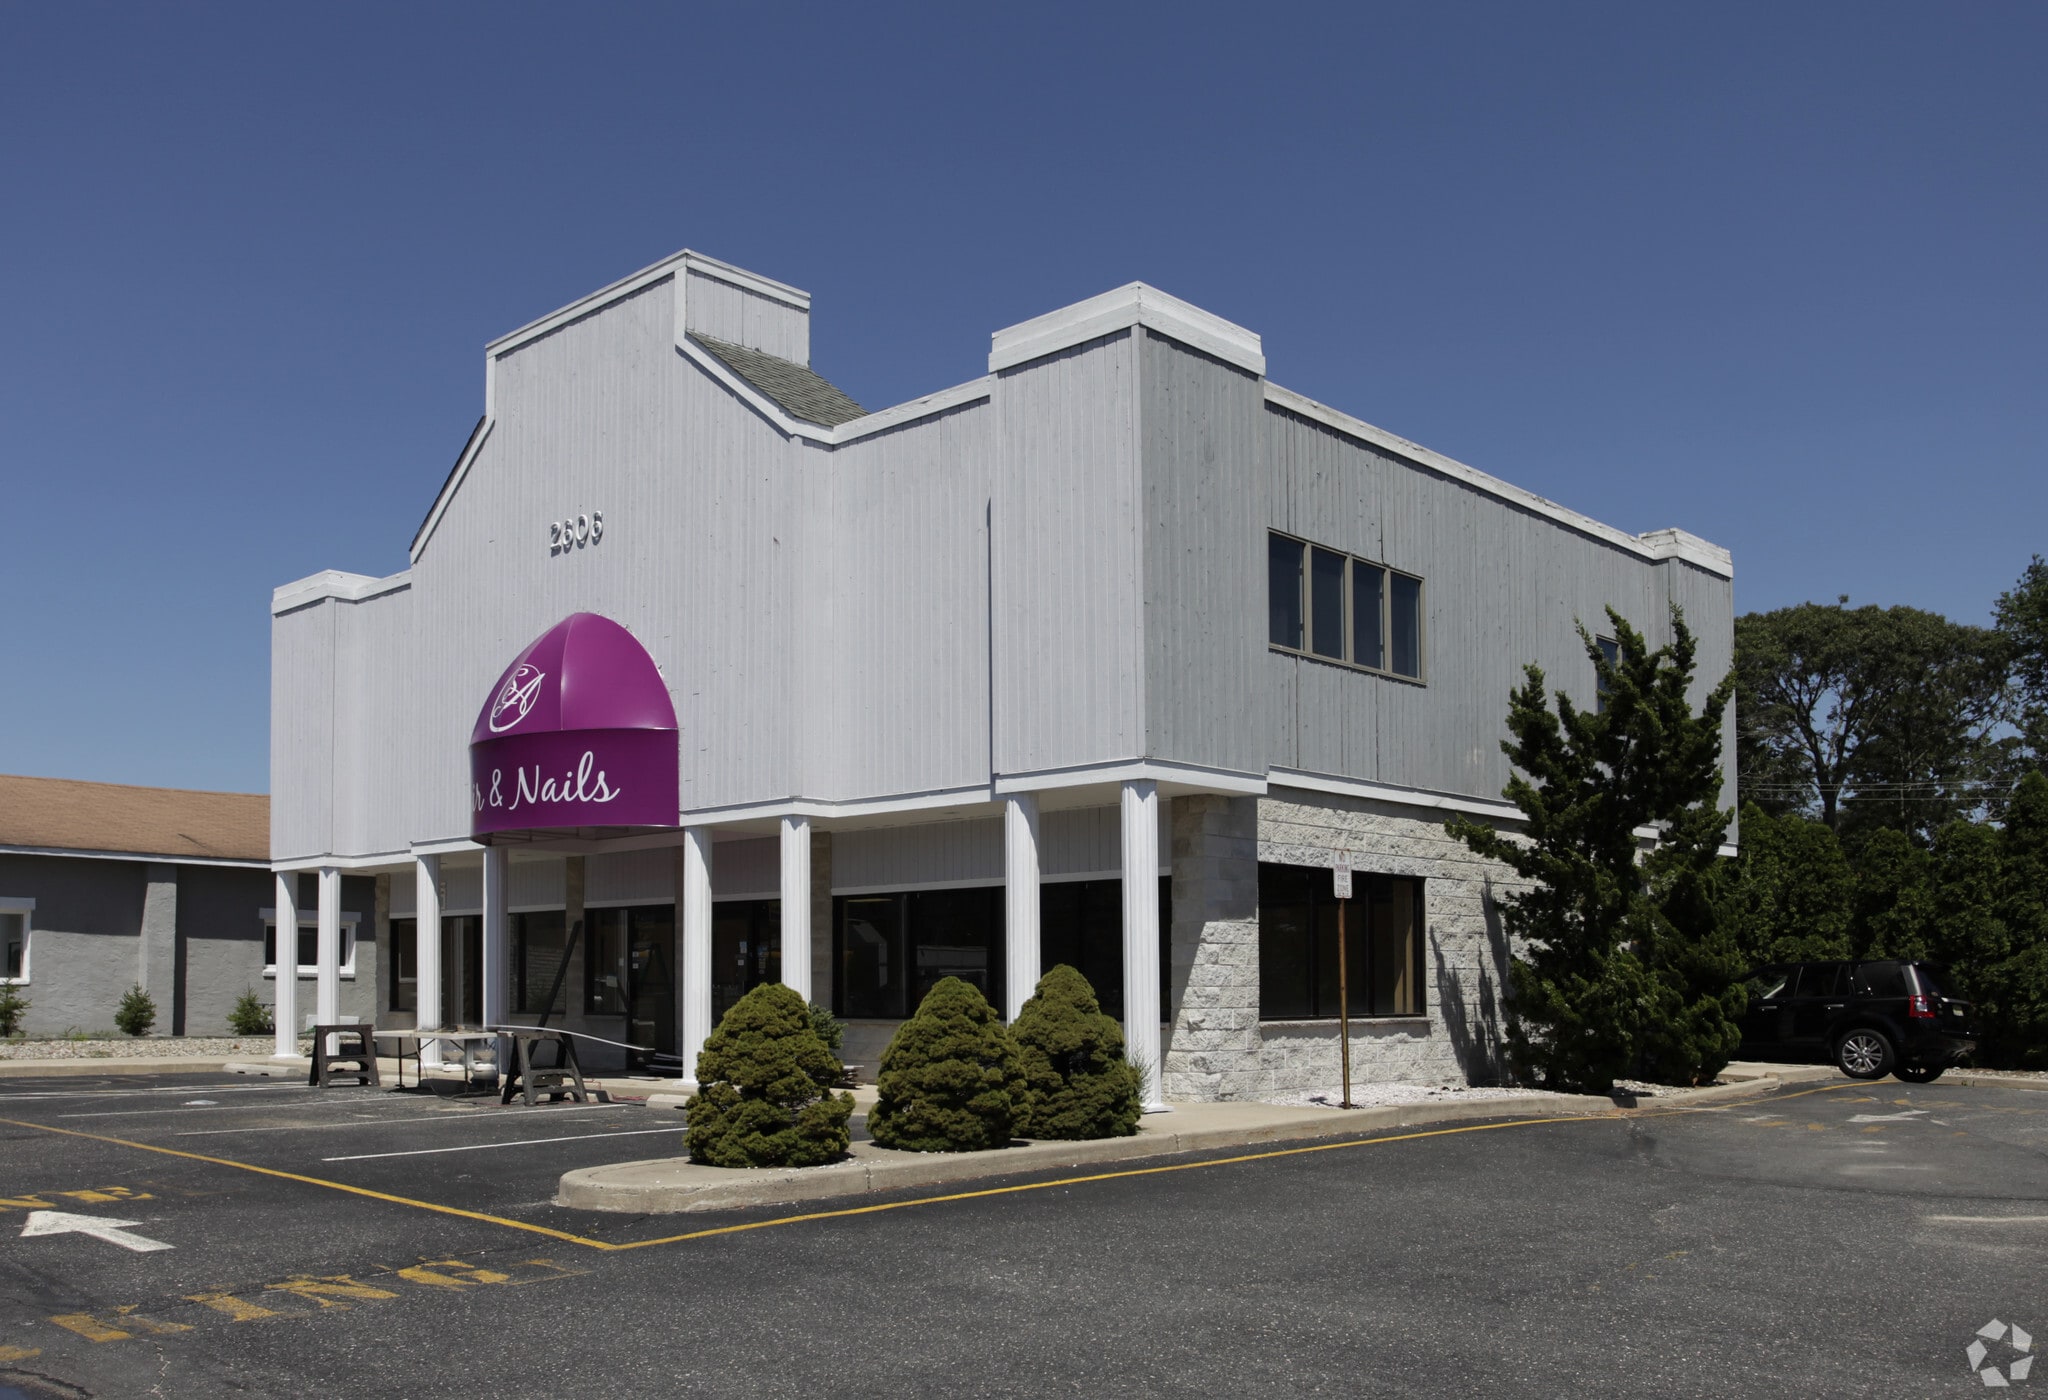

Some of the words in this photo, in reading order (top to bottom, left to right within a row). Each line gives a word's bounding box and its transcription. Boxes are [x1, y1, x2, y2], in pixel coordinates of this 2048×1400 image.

[549, 510, 603, 552] 2606
[489, 768, 503, 807] &
[508, 750, 621, 811] Nails
